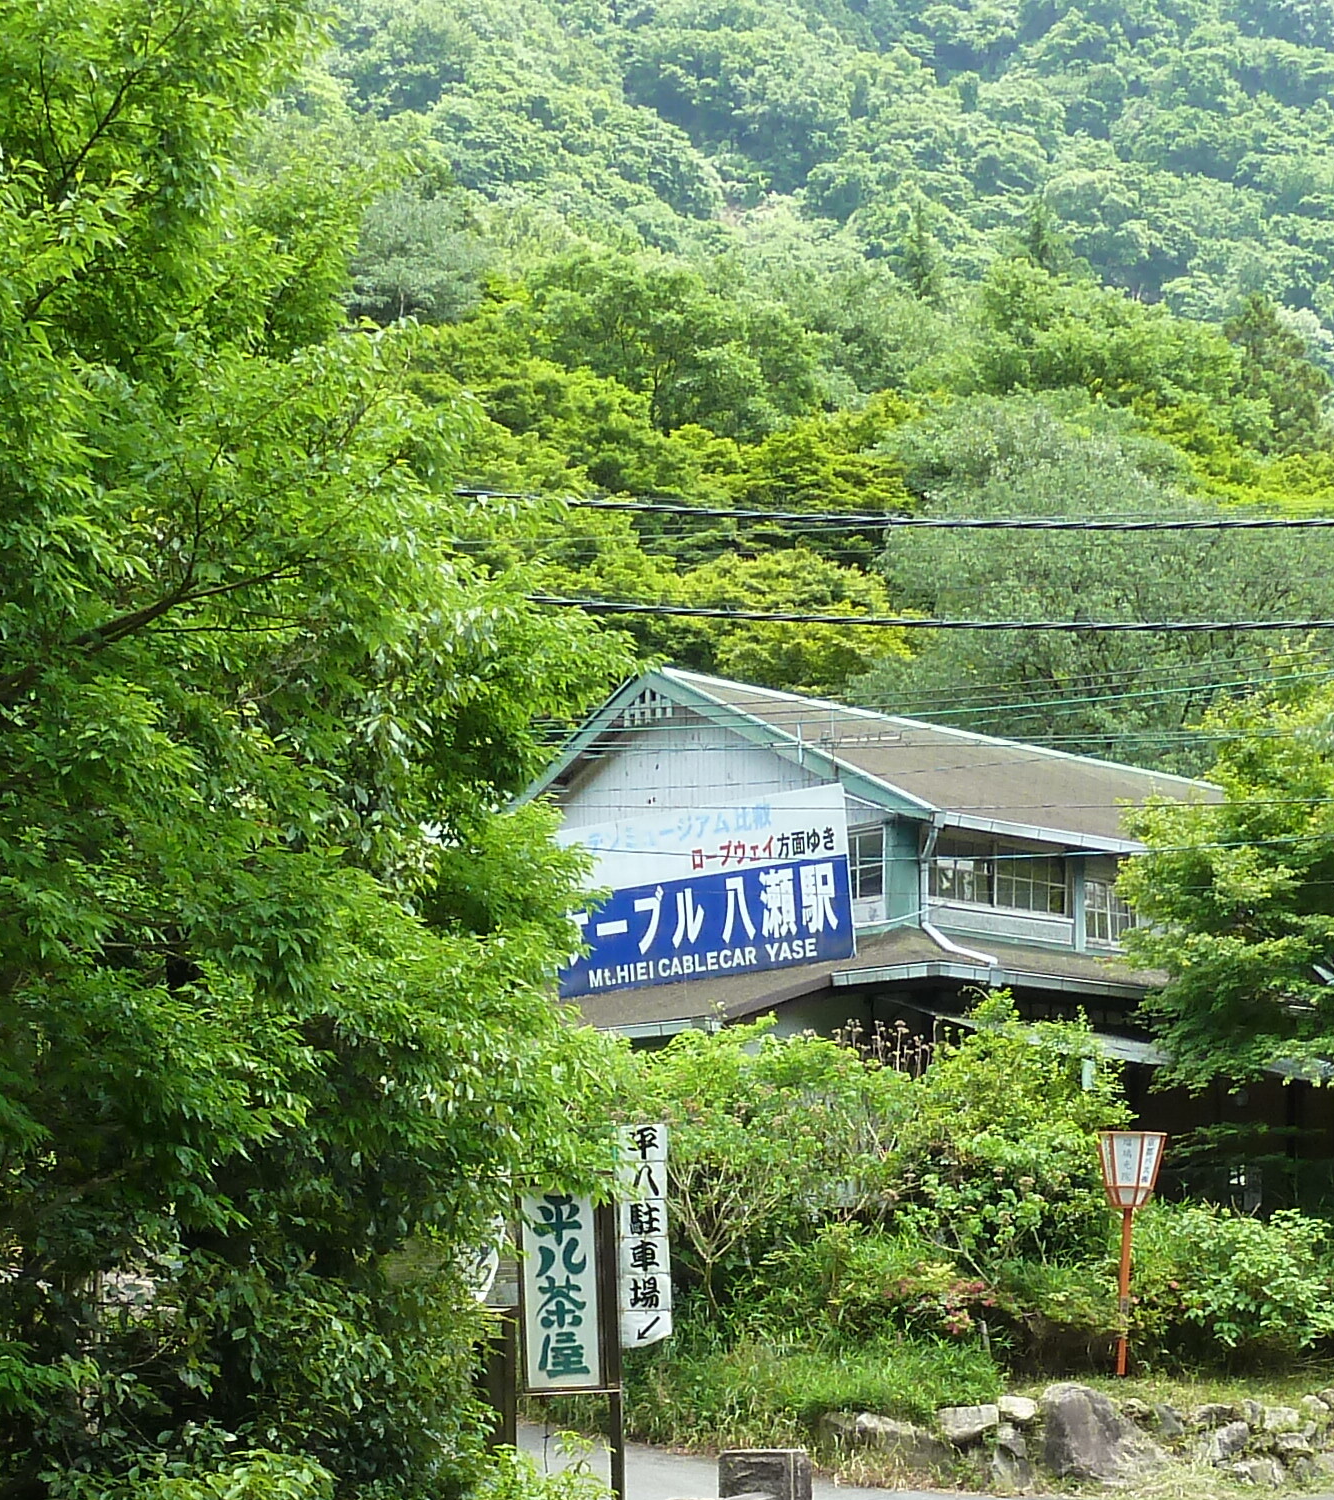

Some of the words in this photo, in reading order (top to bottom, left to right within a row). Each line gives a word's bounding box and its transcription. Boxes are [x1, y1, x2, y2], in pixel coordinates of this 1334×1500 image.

[691, 827, 835, 870] ロープウェイ方面ゆき
[722, 862, 839, 944] 八瀬駅
[588, 960, 655, 989] Mt.HIEI
[658, 946, 757, 978] CABLECAR
[764, 938, 818, 963] YASE
[627, 1126, 662, 1309] 平八駐車場
[532, 1194, 590, 1379] 平八茶屋
